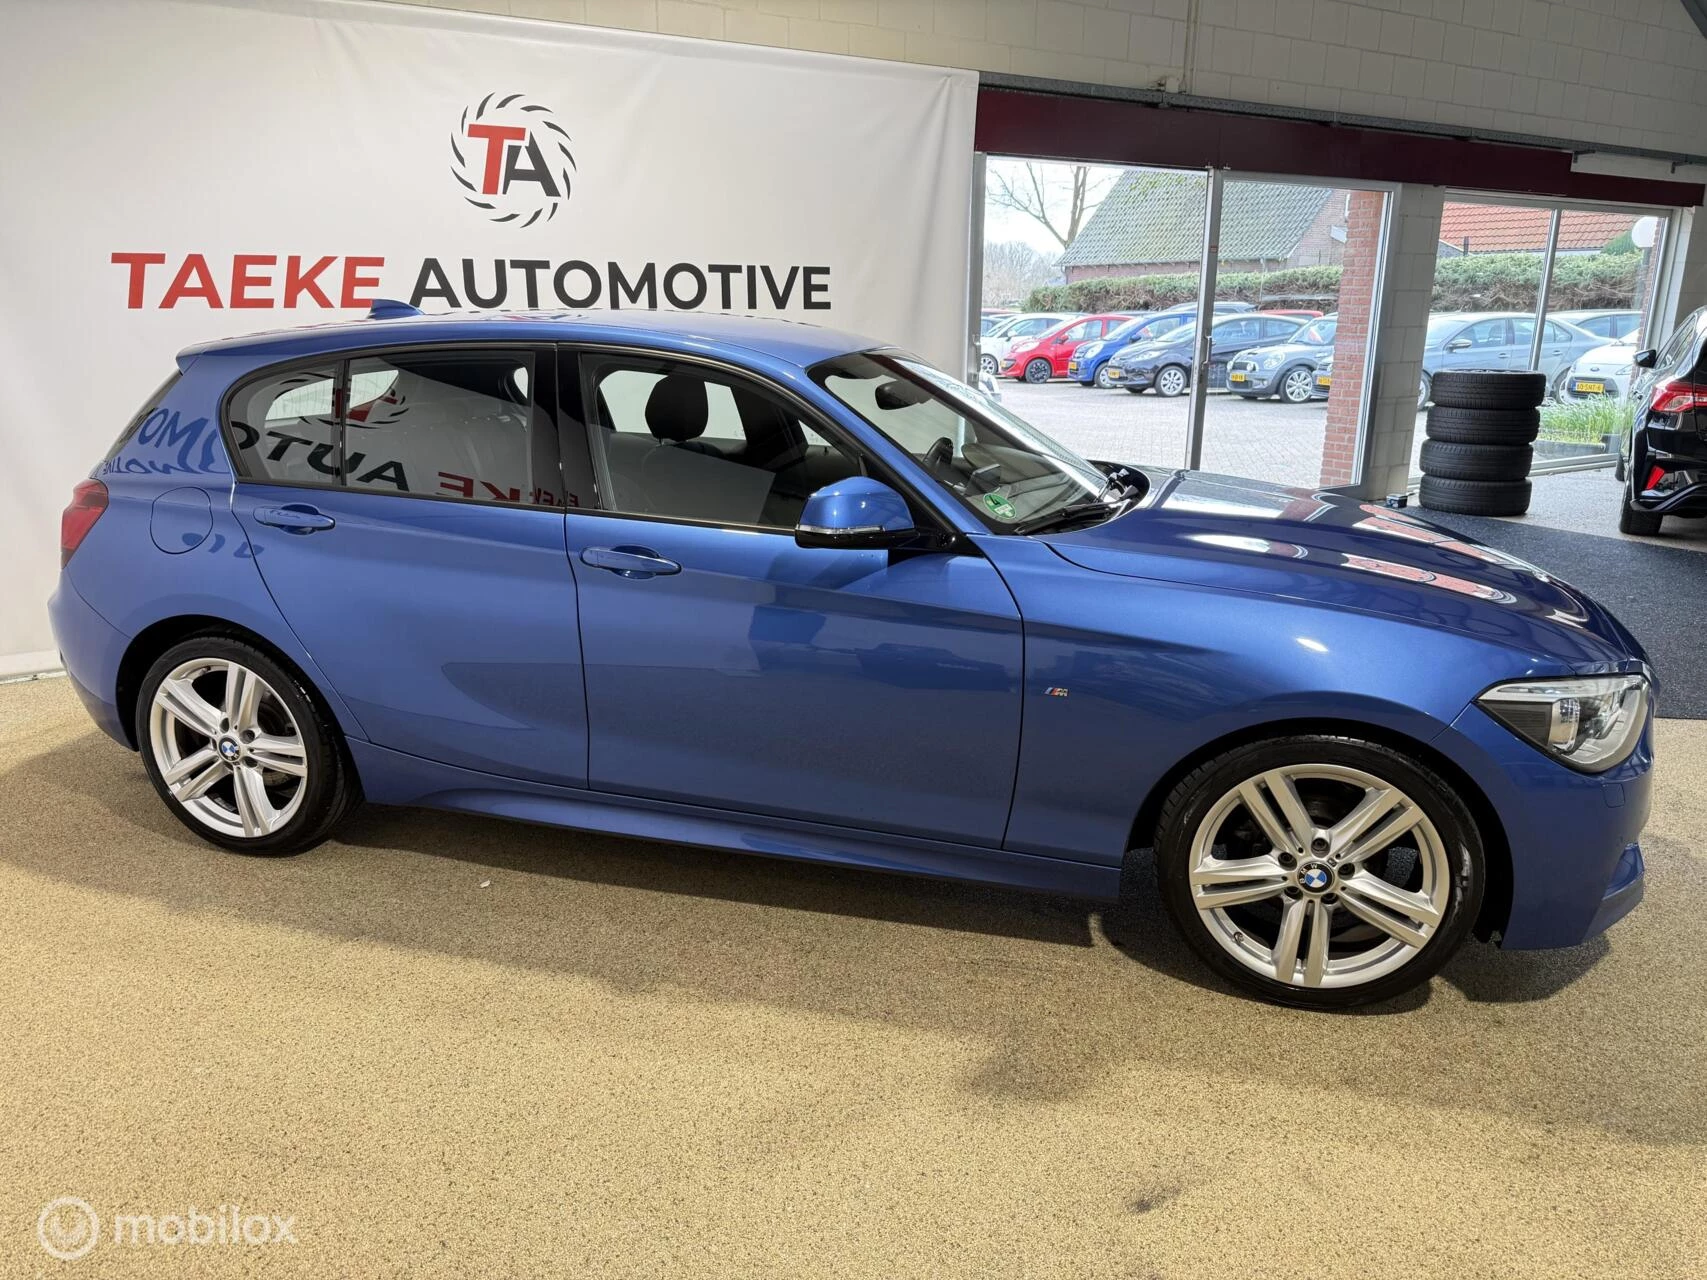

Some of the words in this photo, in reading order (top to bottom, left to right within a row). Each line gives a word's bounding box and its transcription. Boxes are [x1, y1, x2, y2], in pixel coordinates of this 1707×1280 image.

[467, 123, 561, 198] TA
[111, 252, 385, 309] TAEKE
[409, 257, 831, 310] AUTOMOTIVE
